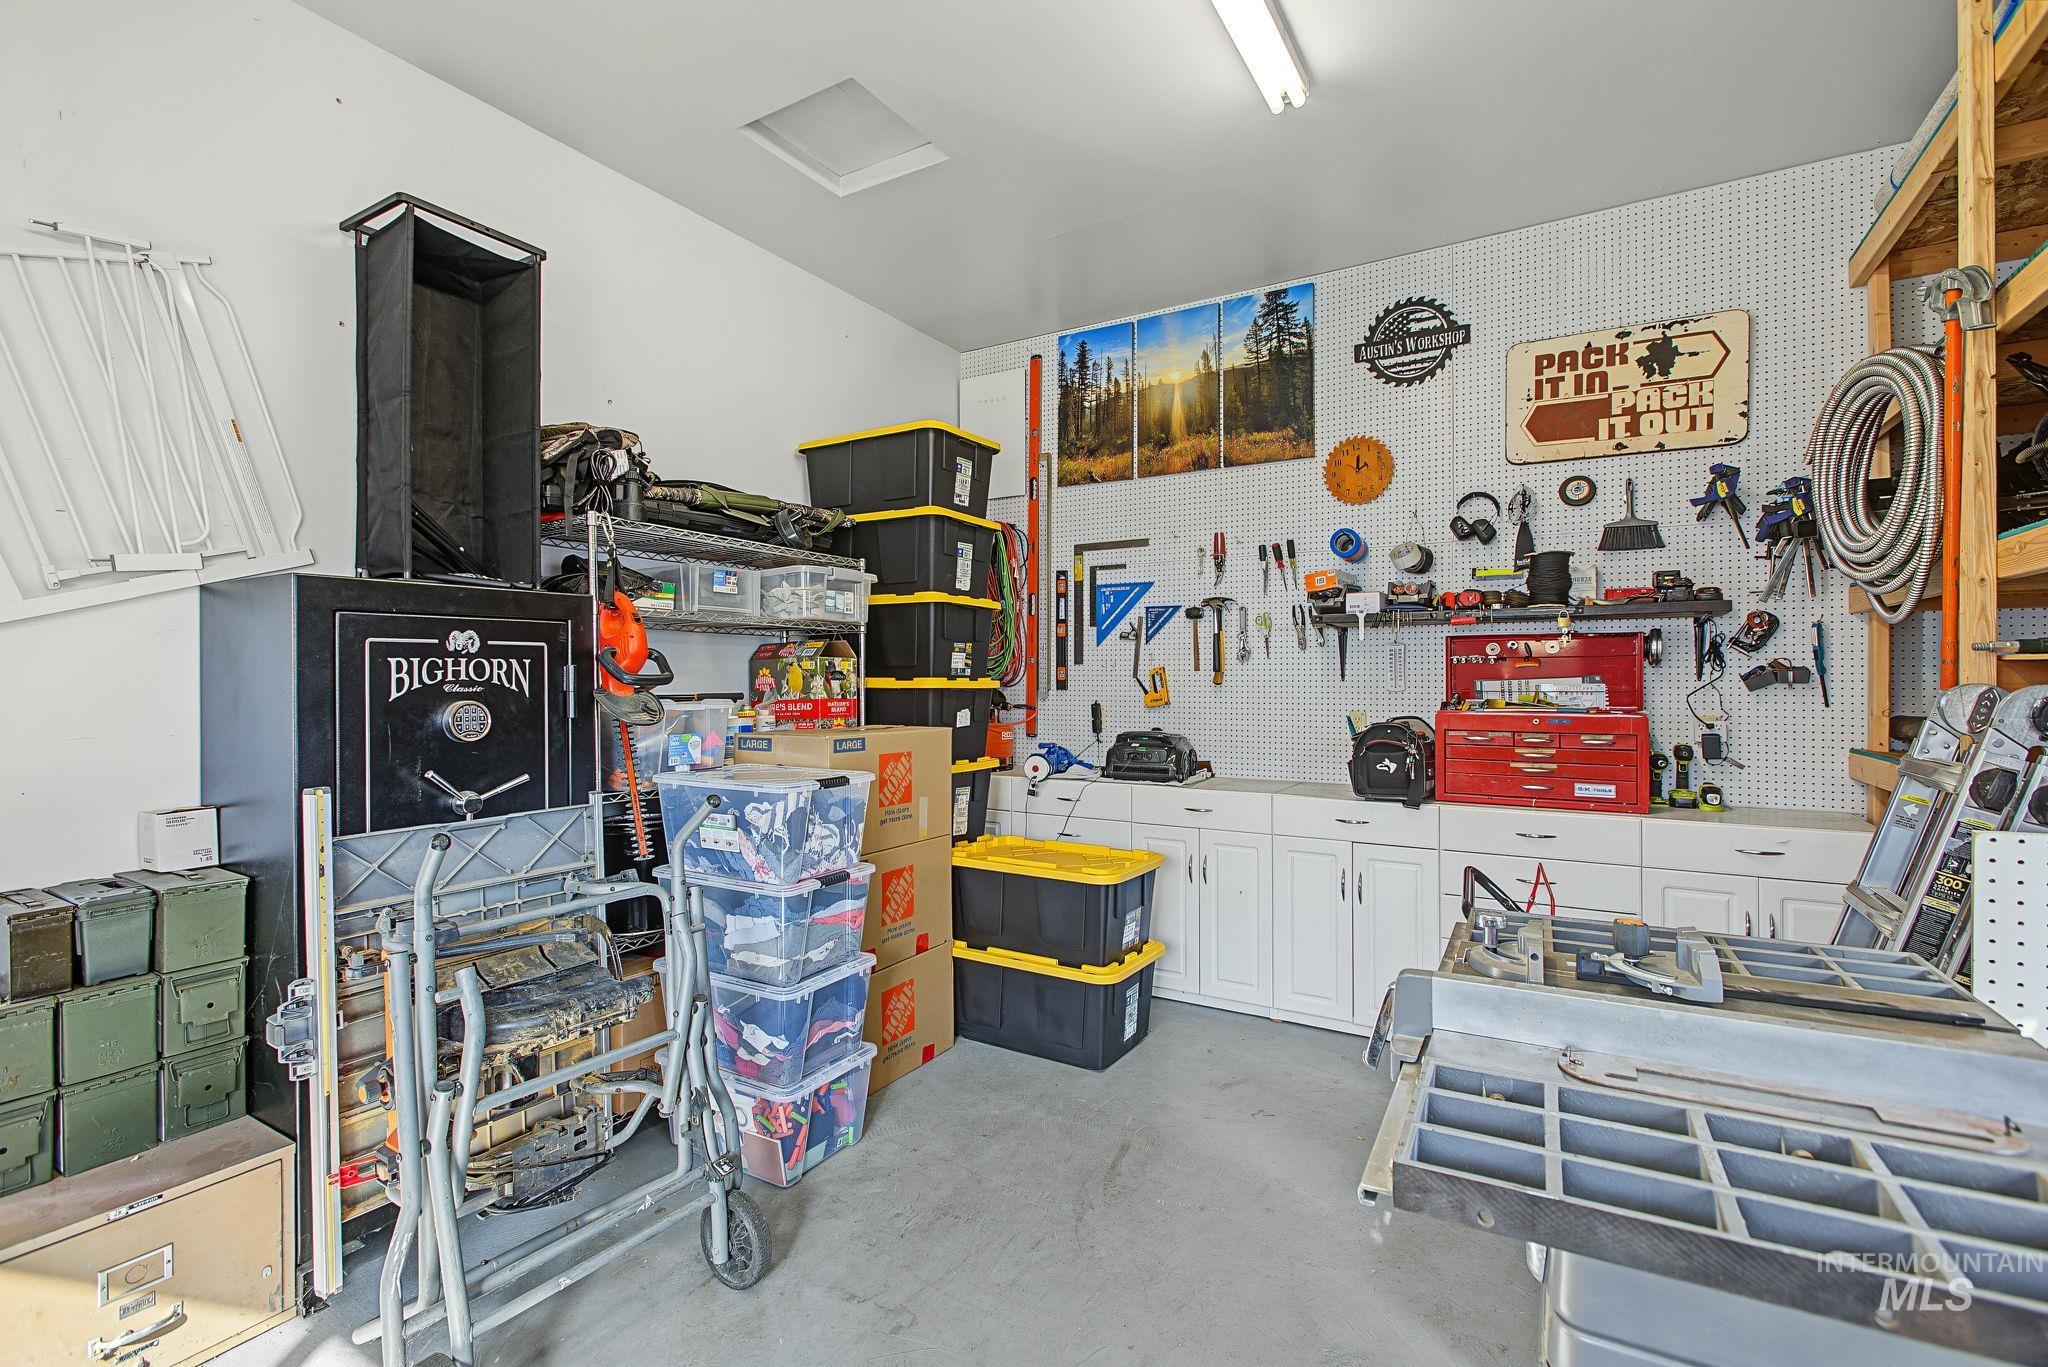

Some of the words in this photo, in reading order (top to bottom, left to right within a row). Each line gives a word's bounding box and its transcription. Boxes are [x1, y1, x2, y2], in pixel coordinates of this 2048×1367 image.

[1360, 340, 1403, 360] AUSTIN'S
[1405, 329, 1466, 352] WORKSHOP
[1534, 342, 1629, 377] PACK
[1534, 376, 1565, 401] IT
[1574, 370, 1608, 396] IN
[1611, 380, 1714, 416] PACK
[1639, 406, 1714, 437] OUT
[387, 657, 531, 702] BIGHORN
[443, 683, 484, 693] Classic
[787, 702, 813, 711] BLEND
[741, 740, 768, 749] LARGE
[836, 740, 863, 750] LARGE
[879, 752, 912, 806] HOME
[1936, 875, 1962, 890] 300
